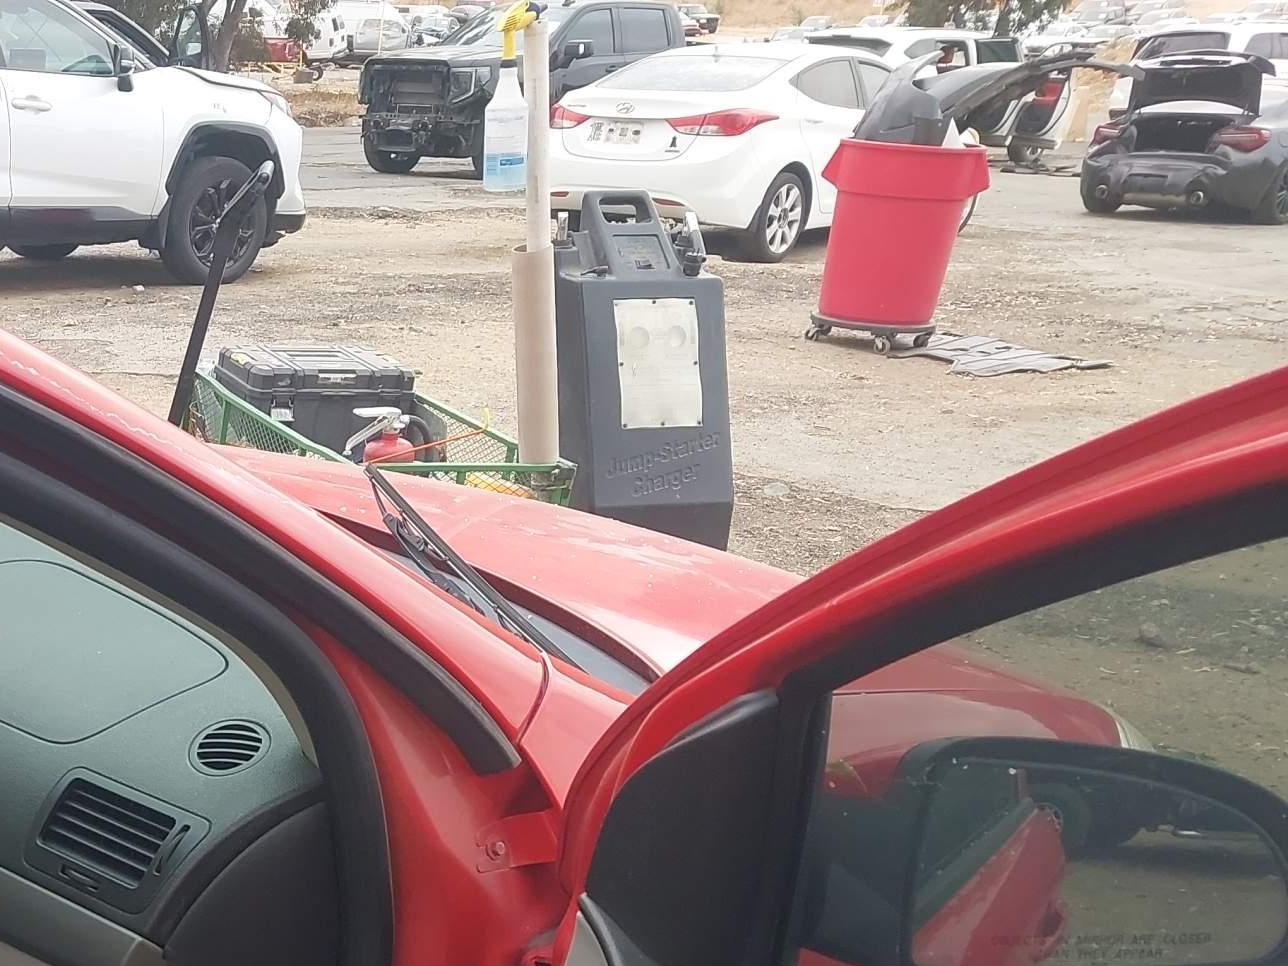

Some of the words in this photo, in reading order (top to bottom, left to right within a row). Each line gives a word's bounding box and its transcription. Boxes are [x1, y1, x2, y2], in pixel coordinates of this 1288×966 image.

[605, 432, 720, 479] Jump-Starter
[631, 463, 701, 498] Charger
[1132, 933, 1154, 945] ARE
[1163, 931, 1211, 945] CLOSER
[1114, 947, 1162, 960] APPEAR
